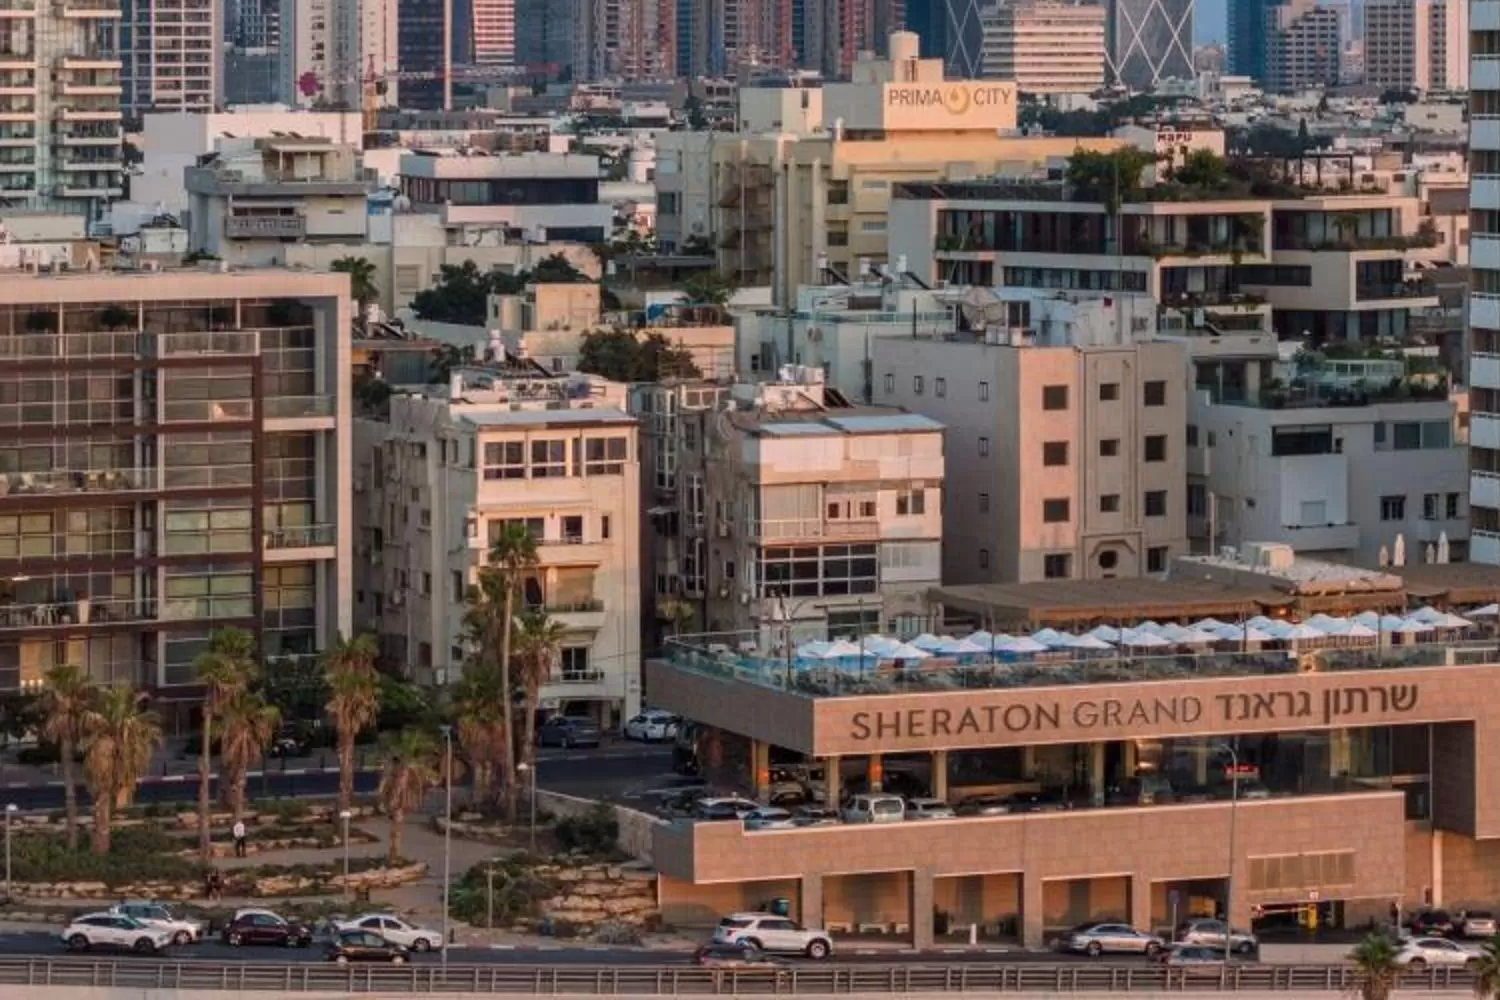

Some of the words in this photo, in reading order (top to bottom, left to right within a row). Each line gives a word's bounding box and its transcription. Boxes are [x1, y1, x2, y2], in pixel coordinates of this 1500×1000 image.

[888, 88, 943, 106] PRIMA
[973, 87, 1012, 106] CITY
[850, 702, 1060, 741] SHERATON
[1072, 695, 1203, 729] GRAND
[1215, 690, 1312, 721] גראנד
[1322, 684, 1419, 724] שרתון
